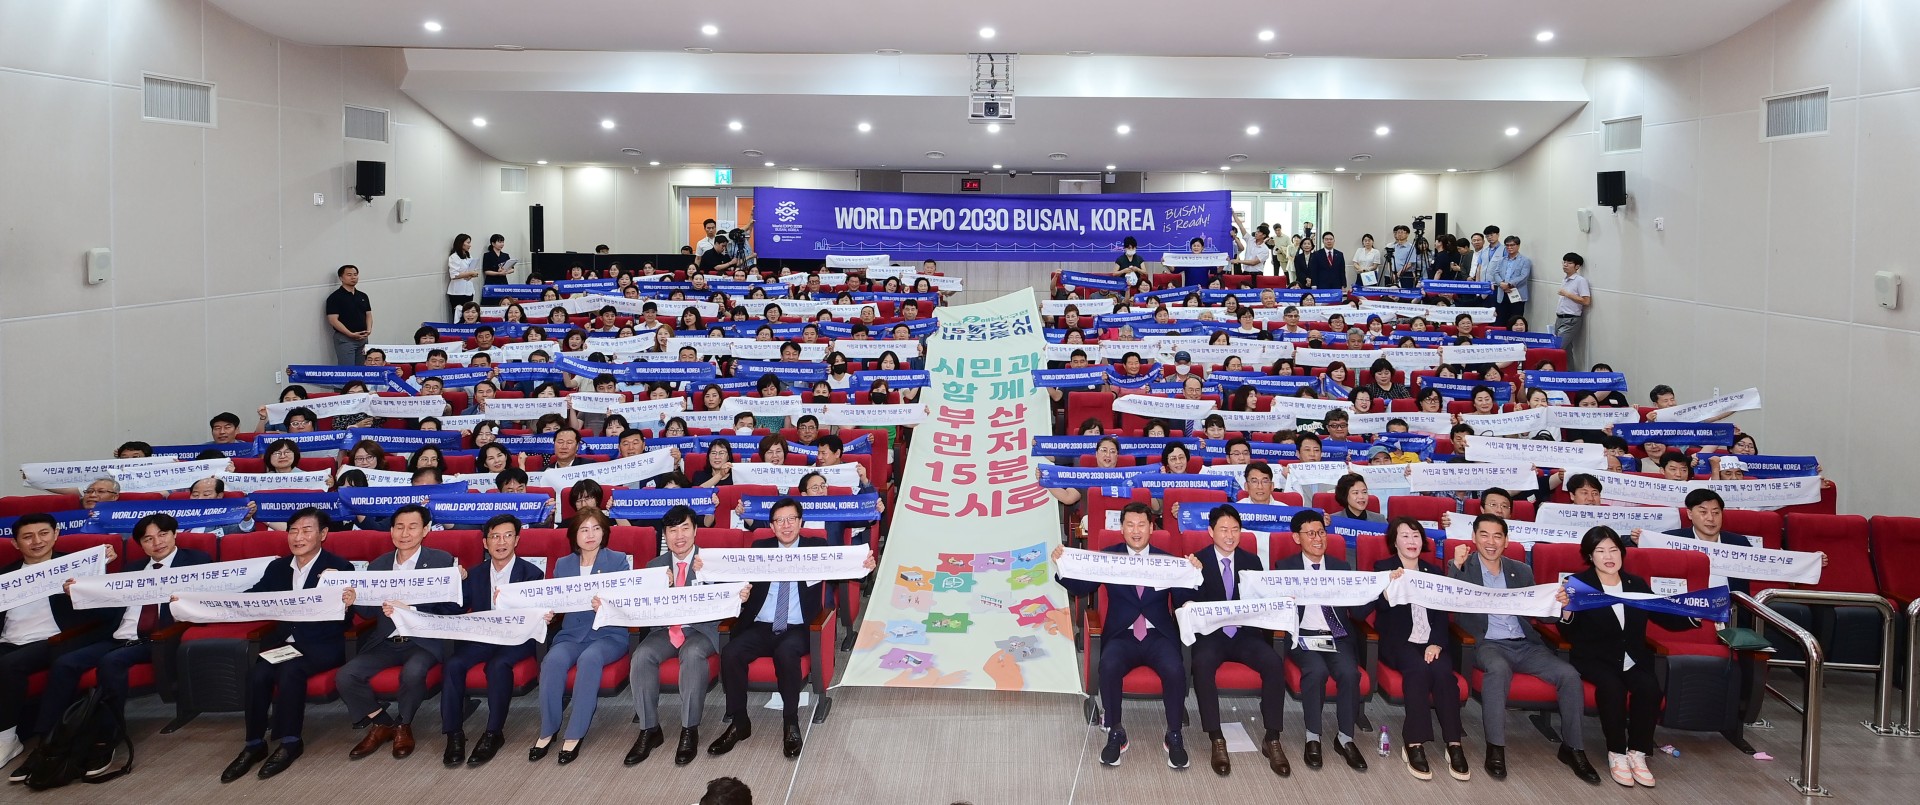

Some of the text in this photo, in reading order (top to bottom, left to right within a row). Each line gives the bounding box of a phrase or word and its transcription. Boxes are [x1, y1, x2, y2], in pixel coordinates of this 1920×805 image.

[1165, 204, 1205, 221] BUSAN
[835, 207, 1155, 236] WORLD EXPO 2030 BUSAN, KOREA
[1163, 214, 1210, 232] is Ready!
[932, 353, 1040, 378] 시민과
[942, 379, 1038, 402] 함께,
[938, 404, 1026, 428] 부산
[934, 428, 1028, 456] 먼저
[562, 472, 579, 480] 시민과
[582, 470, 596, 478] 함께,
[611, 464, 622, 472] 먼저
[638, 458, 654, 466] 도시로
[926, 456, 1028, 484] 15분
[351, 497, 374, 505] WORLD
[393, 496, 410, 504] 2030
[459, 503, 476, 511] EXPO
[494, 503, 518, 511] BUSAN,
[520, 502, 541, 510] KOREA
[815, 502, 837, 510] BUSAN,
[906, 482, 1050, 517] 도시로
[112, 511, 137, 519] WORLD
[176, 509, 201, 517] BUSAN,
[1093, 553, 1109, 563] 함께,
[1112, 554, 1128, 564] 부산
[1129, 555, 1143, 565] 먼저
[1146, 558, 1161, 566] 15분
[1164, 557, 1187, 567] 도시로
[1666, 541, 1793, 564] 시민과 함께, 부산 먼저 15분 도시로
[1, 554, 98, 590] 부산 먼저 15분 도시로
[105, 568, 247, 590] 시민과 함께, 부산 먼저 15분 도시로
[1261, 576, 1376, 585] 시민과 함께, 부산 먼저 15분 도시로
[350, 579, 368, 588] 함께,
[371, 579, 387, 587] 부산
[390, 579, 405, 587] 먼저
[409, 578, 424, 586] 15분
[427, 576, 450, 585] 도시로
[520, 577, 642, 597] 시민과 함께, 부산 먼저 15분 도시로
[1410, 579, 1433, 590] 시민과
[1436, 584, 1454, 594] 함께,
[1457, 587, 1472, 595] 부산
[261, 599, 278, 607] 먼저
[299, 595, 322, 604] 도시로
[609, 592, 729, 608] 시민과 함께, 부산 먼저 15분 도시로
[1191, 601, 1296, 616] 시민과 함께, 부산 먼저 15분 도
[1684, 598, 1709, 607] KOREA
[505, 616, 525, 624] 도시로
